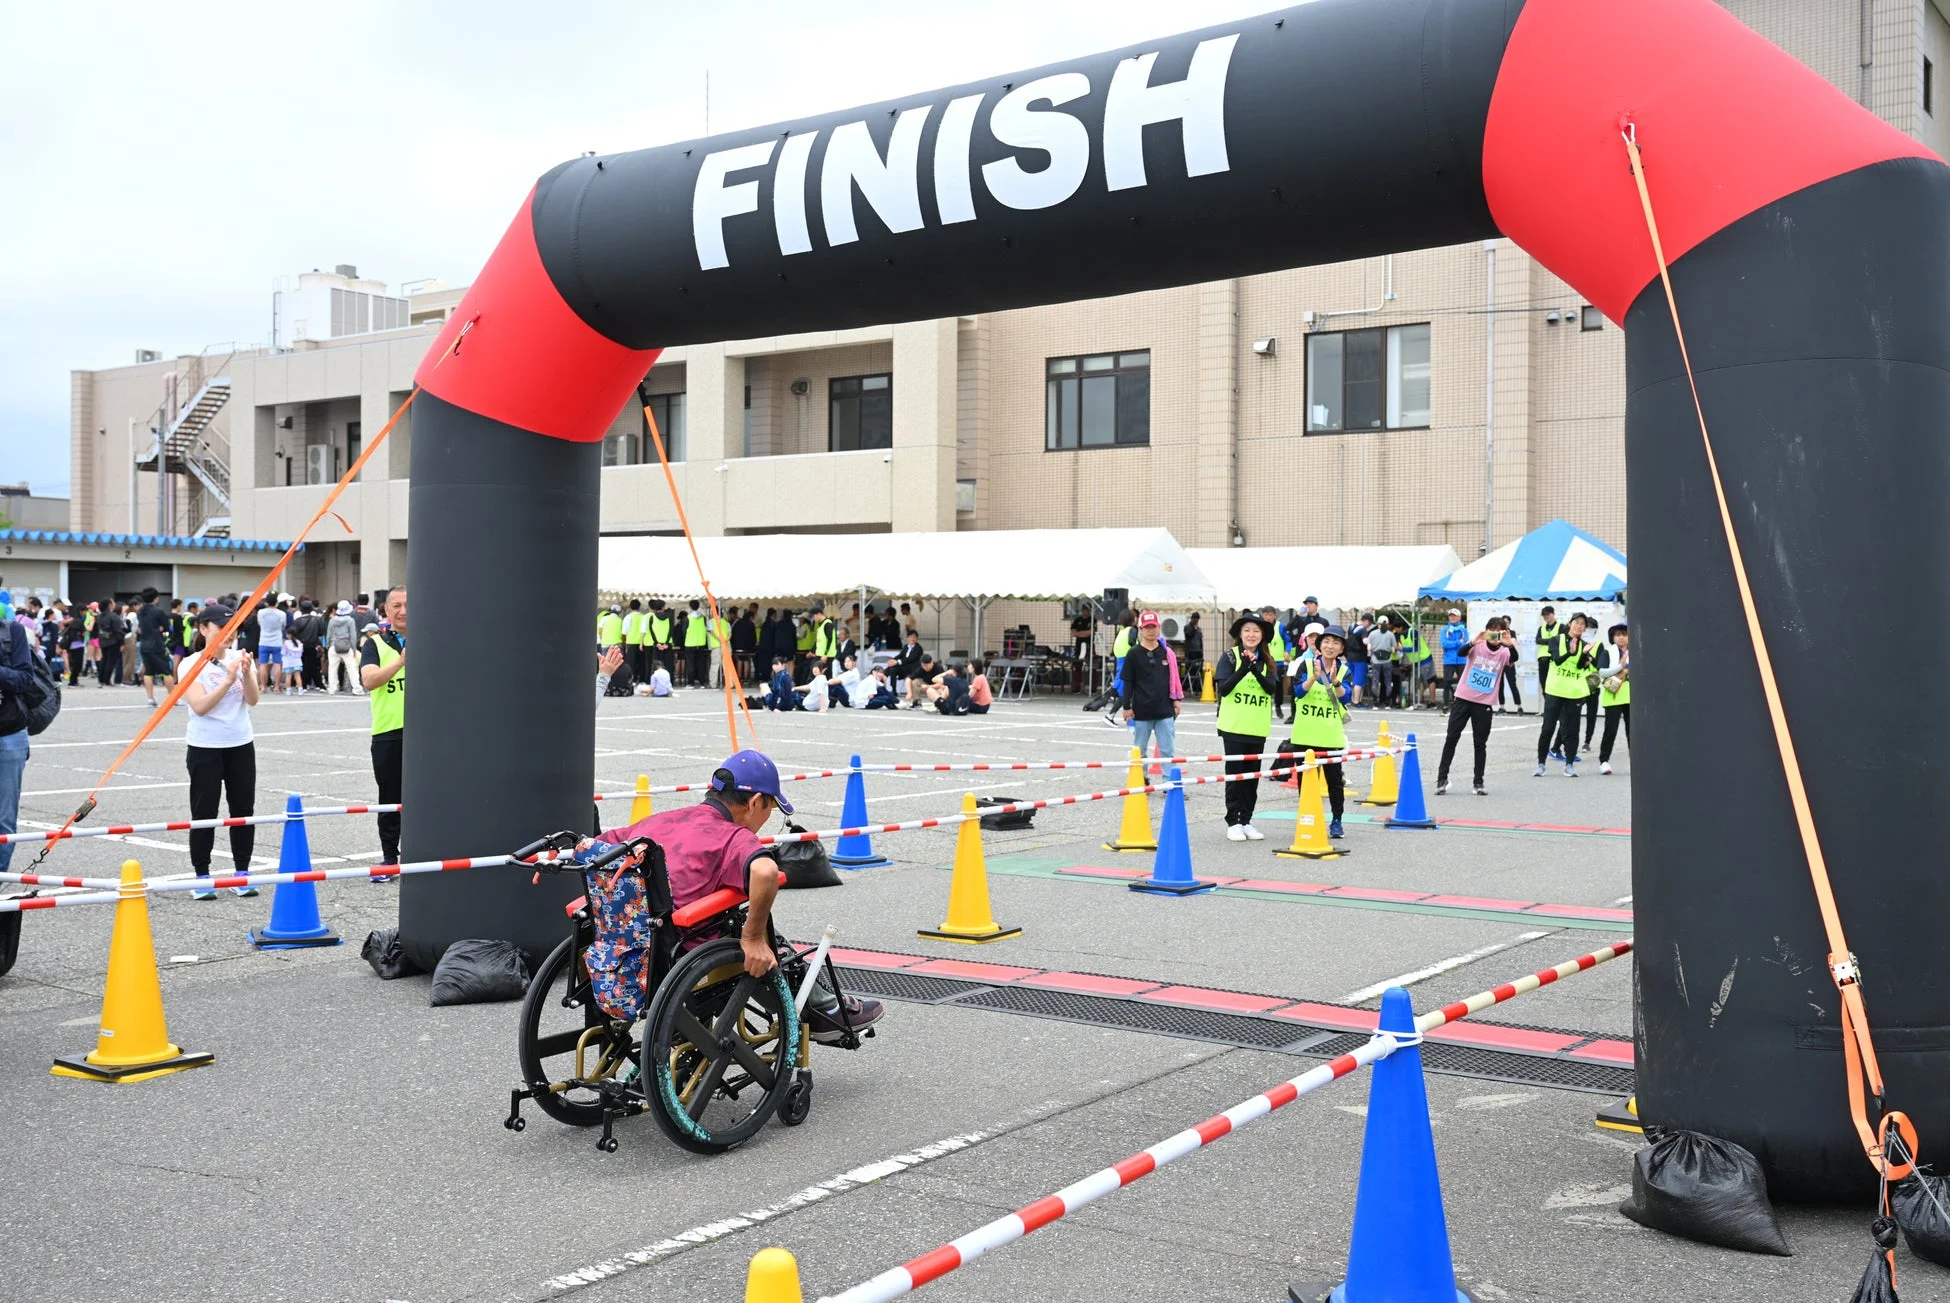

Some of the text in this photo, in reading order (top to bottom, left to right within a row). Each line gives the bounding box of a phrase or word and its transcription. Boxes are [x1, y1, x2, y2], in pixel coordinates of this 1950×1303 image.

[692, 33, 1241, 271] FINISH
[5, 546, 13, 555] 3
[124, 550, 131, 559] 2
[1471, 672, 1493, 689] 5601
